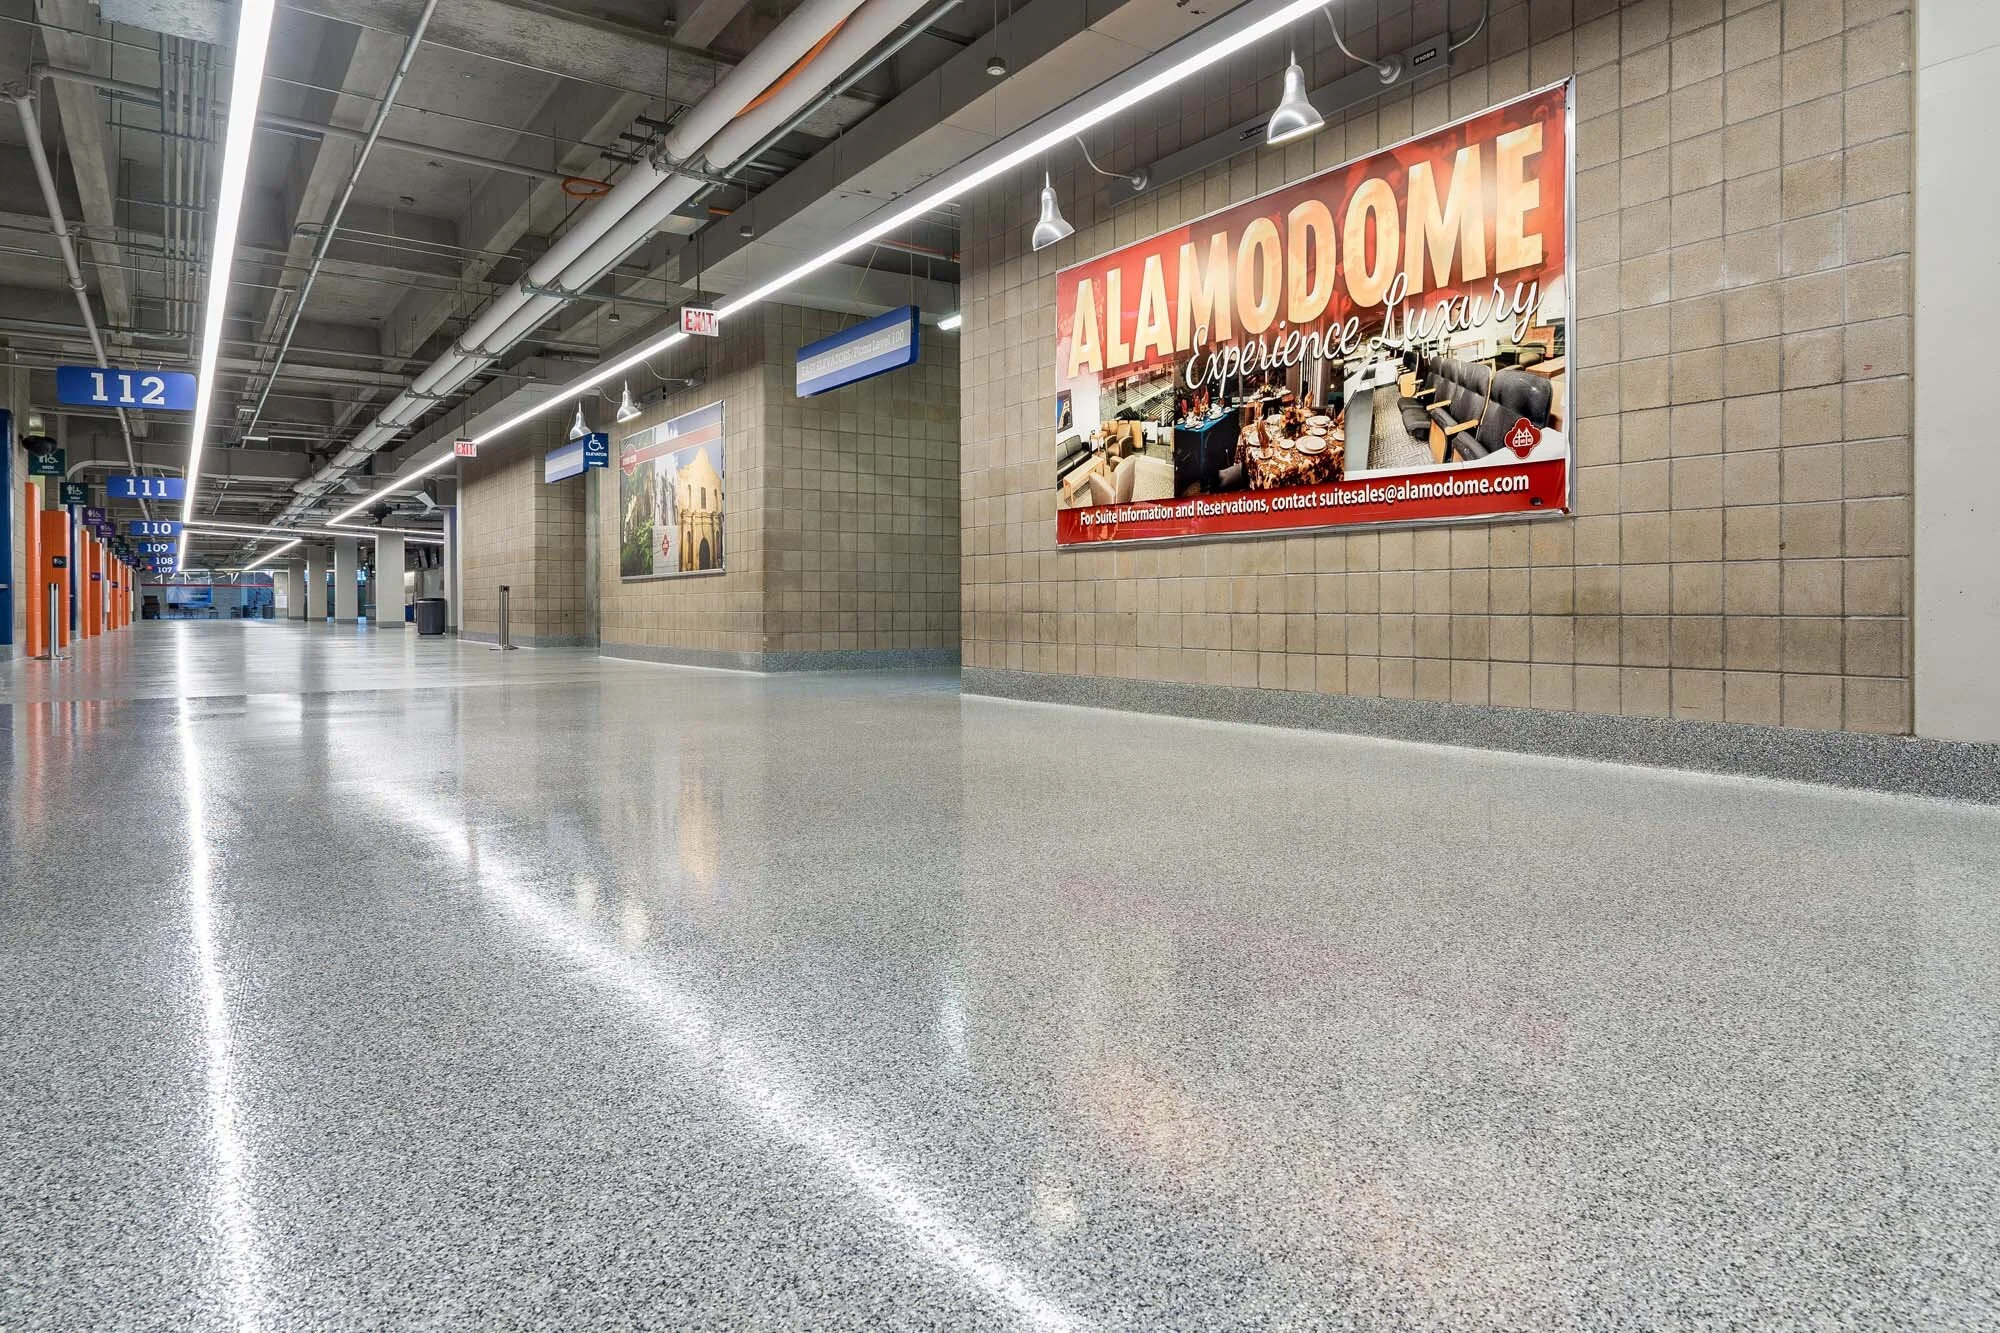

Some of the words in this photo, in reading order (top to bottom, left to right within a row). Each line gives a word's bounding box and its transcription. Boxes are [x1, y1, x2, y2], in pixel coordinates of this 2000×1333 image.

[1067, 121, 1543, 379] ALAMODOME
[685, 310, 714, 333] EXIT
[1186, 316, 1362, 398] Experience
[1370, 272, 1545, 349] Luxury
[91, 372, 165, 405] 112
[456, 442, 473, 455] EXIT
[126, 479, 168, 497] 111
[1080, 511, 1094, 525] For
[1095, 509, 1117, 524] Suite
[1119, 504, 1173, 522] Information
[1175, 501, 1194, 518] and
[1197, 495, 1270, 516] Reservations,
[1272, 491, 1317, 510] contact
[1319, 473, 1529, 506] suitesales@alamodome.com
[142, 522, 172, 535] 110
[146, 543, 169, 553] 109
[155, 557, 174, 565] 108
[157, 566, 172, 574] 107
